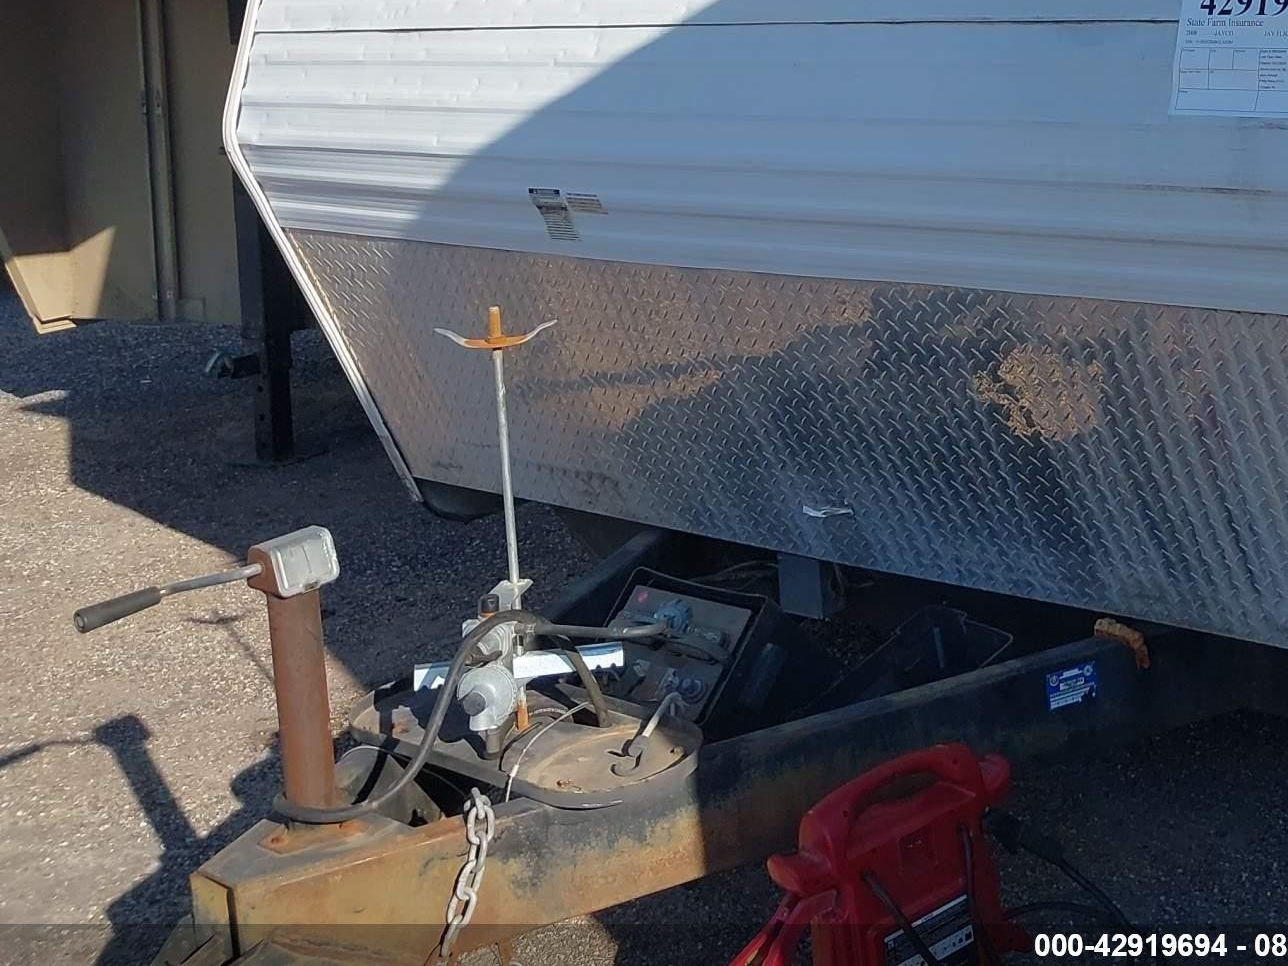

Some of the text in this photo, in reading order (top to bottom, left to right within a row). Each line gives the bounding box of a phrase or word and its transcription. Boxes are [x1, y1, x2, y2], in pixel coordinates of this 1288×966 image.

[1186, 17, 1265, 27] State Farm Insurance
